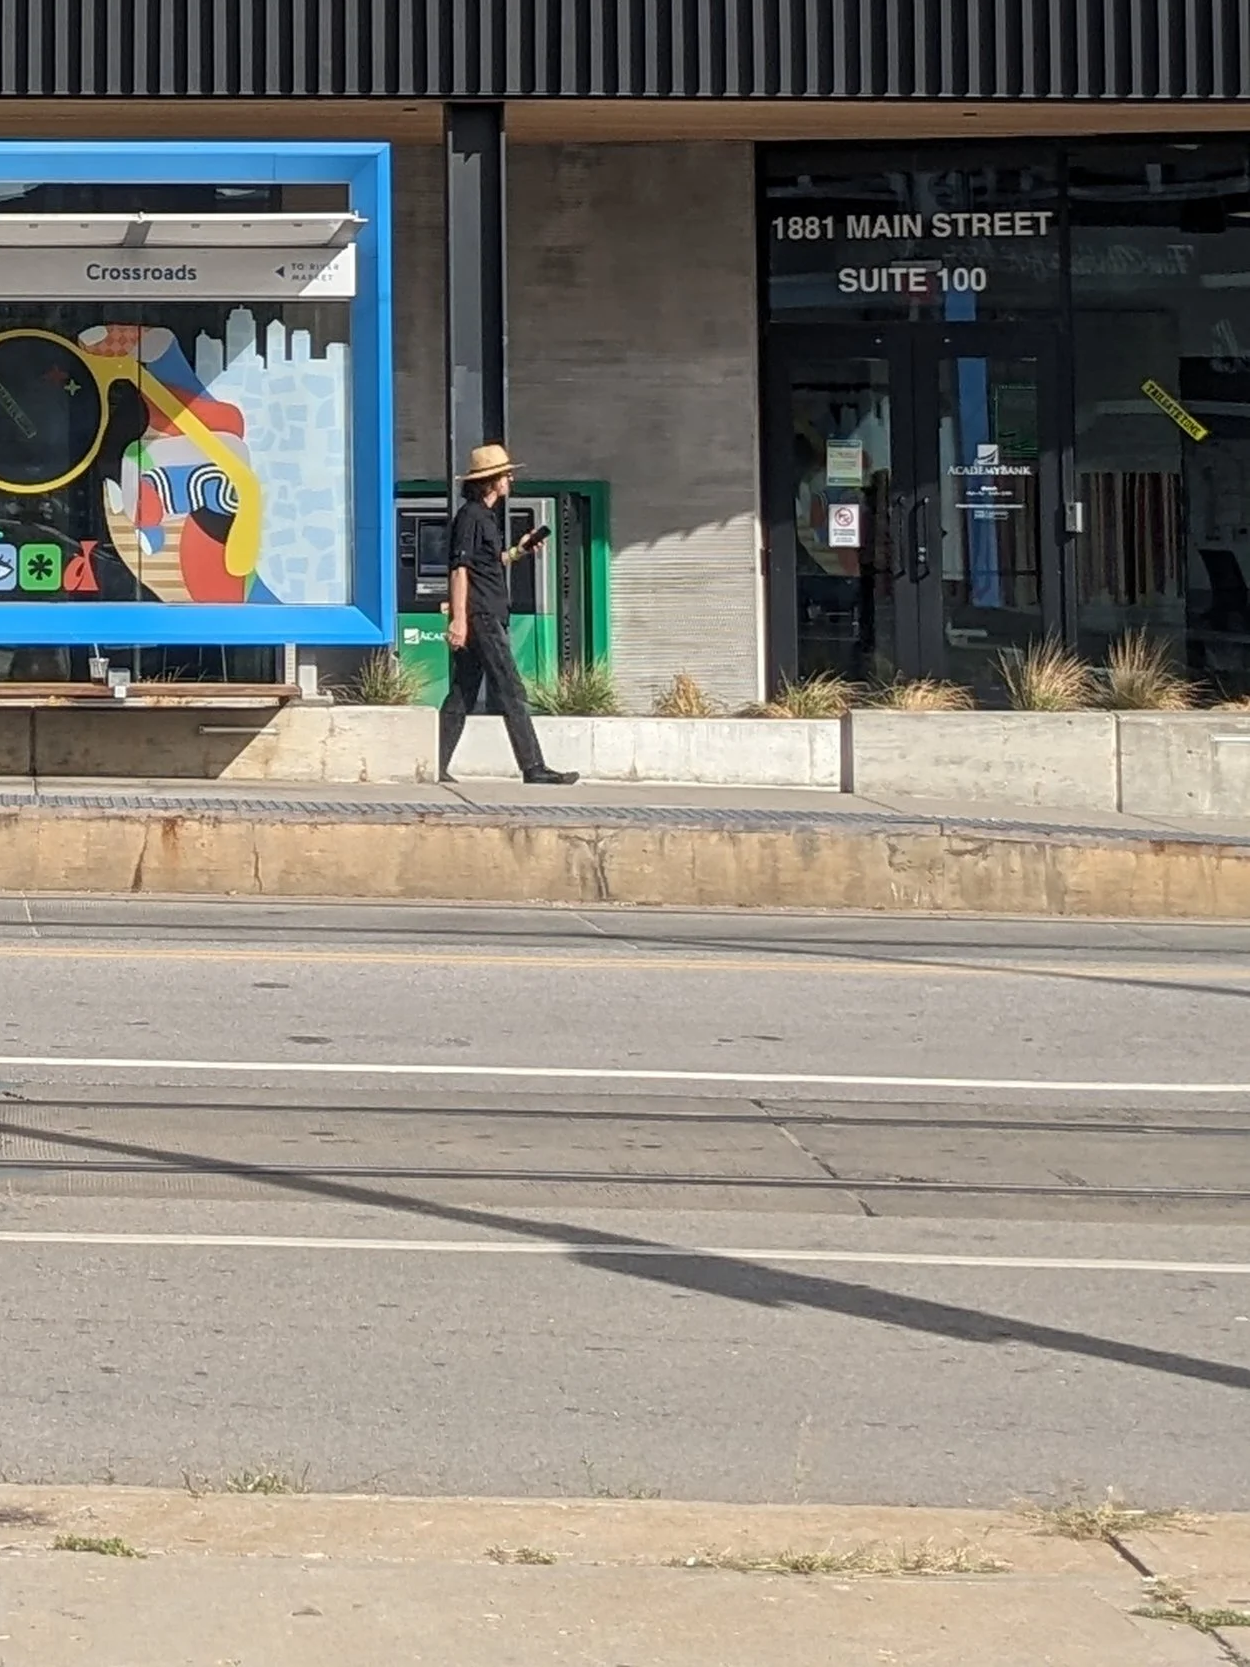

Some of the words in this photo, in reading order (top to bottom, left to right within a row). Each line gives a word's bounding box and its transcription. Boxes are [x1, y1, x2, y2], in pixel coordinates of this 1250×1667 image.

[771, 216, 835, 240] 1881
[846, 214, 922, 239] MAIN
[932, 211, 1053, 237] STREET
[86, 264, 198, 281] Crossroads
[838, 268, 928, 293] SUITE
[936, 268, 987, 292] 100
